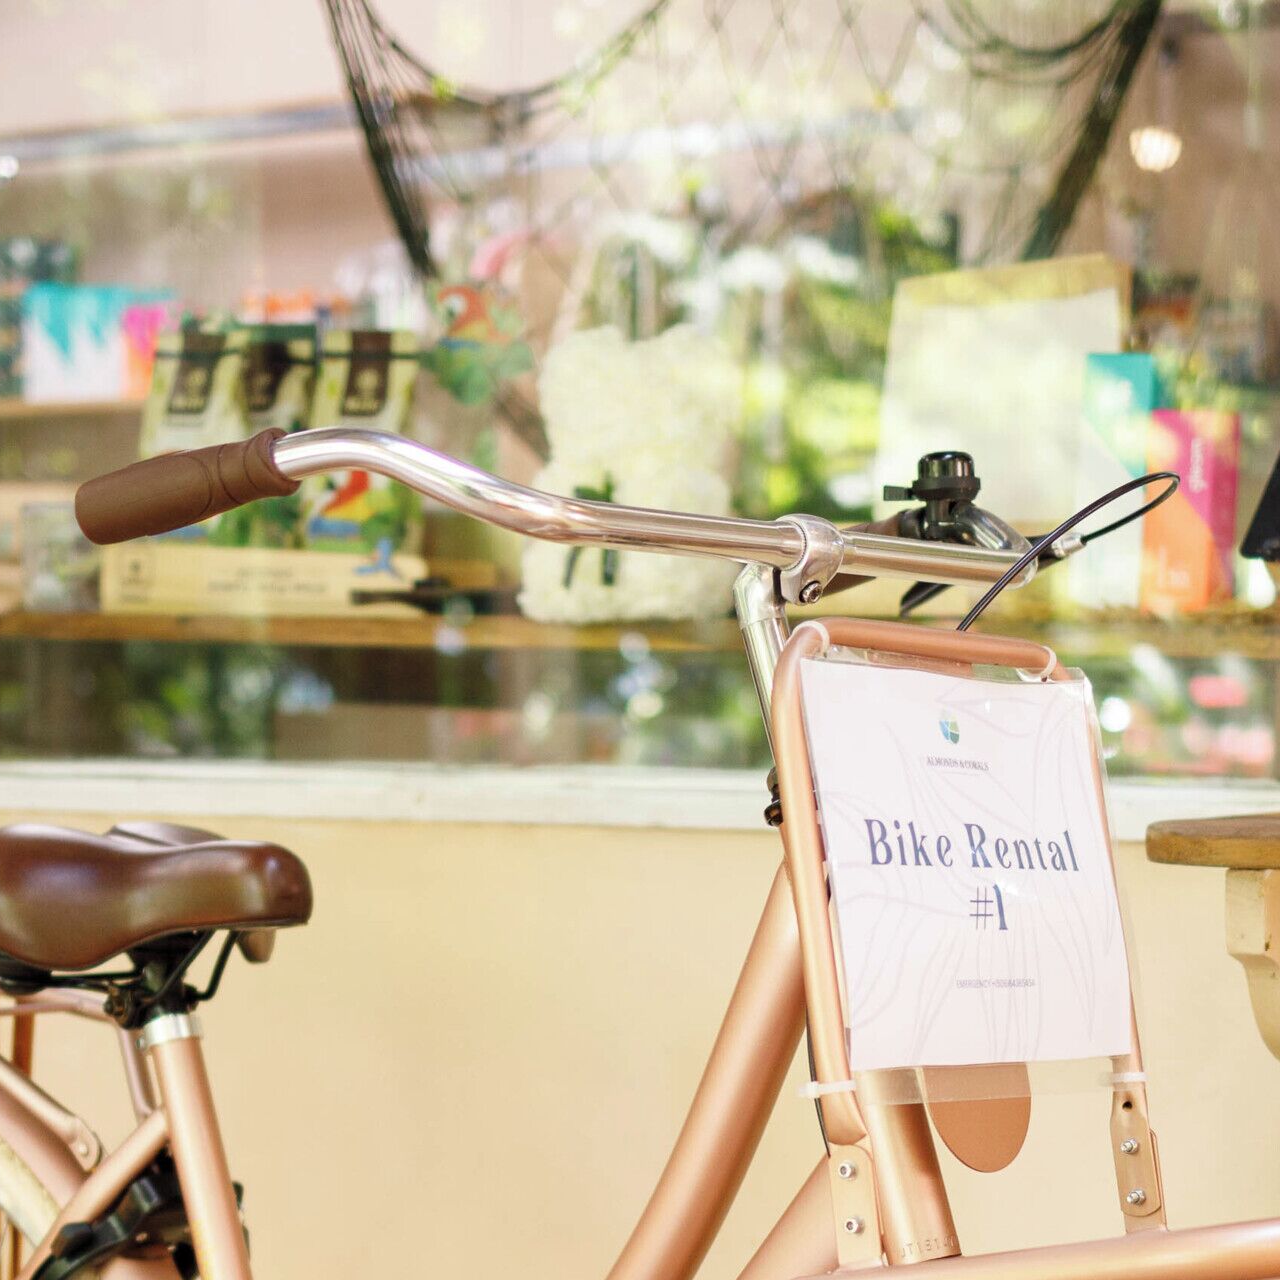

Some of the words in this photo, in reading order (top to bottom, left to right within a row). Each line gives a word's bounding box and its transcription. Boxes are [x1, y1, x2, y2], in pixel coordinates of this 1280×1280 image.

[864, 818, 954, 867] Bike
[964, 822, 1080, 872] Rental
[969, 883, 1009, 931] #1
